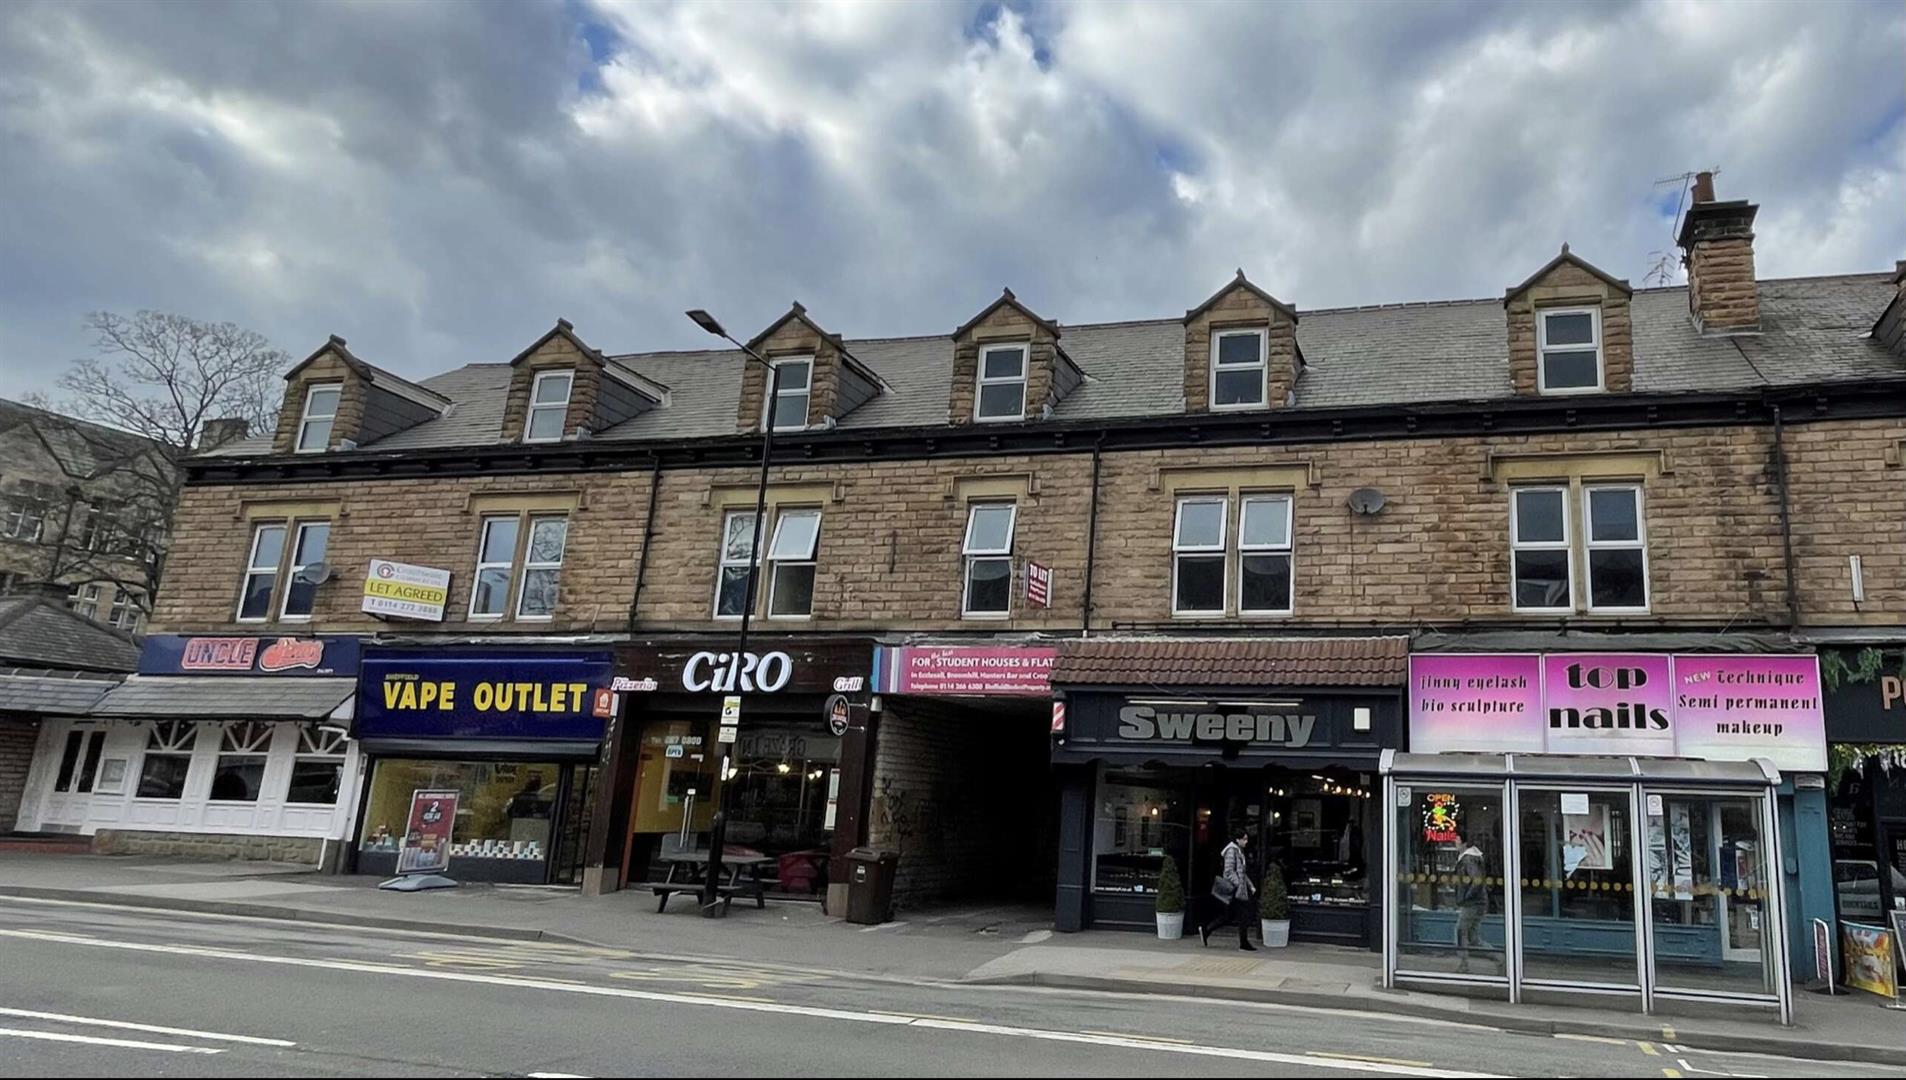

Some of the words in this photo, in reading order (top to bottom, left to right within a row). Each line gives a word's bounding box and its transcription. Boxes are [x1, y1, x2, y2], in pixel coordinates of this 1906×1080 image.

[370, 582, 391, 595] LET
[394, 586, 443, 602] AGREED
[186, 638, 257, 666] UNCLE
[912, 657, 931, 667] FOR
[937, 657, 979, 667] STUDENT
[981, 657, 1020, 667] HOUSES
[1022, 658, 1029, 667] &
[833, 676, 864, 691] Grill
[1467, 674, 1527, 690] eyelash
[1565, 663, 1648, 689] top
[1684, 671, 1711, 684] NEW
[383, 682, 455, 710] VAPE
[473, 682, 588, 713] OUTLET
[1679, 694, 1718, 708] Semi
[1725, 697, 1817, 711] permanent
[1421, 698, 1444, 712] bio
[1451, 698, 1525, 714] sculpture
[1549, 702, 1669, 730] nails
[1119, 706, 1316, 748] Sweeny
[1717, 720, 1783, 736] makeup
[1427, 793, 1455, 802] OPEN
[1425, 829, 1457, 842] Nails
